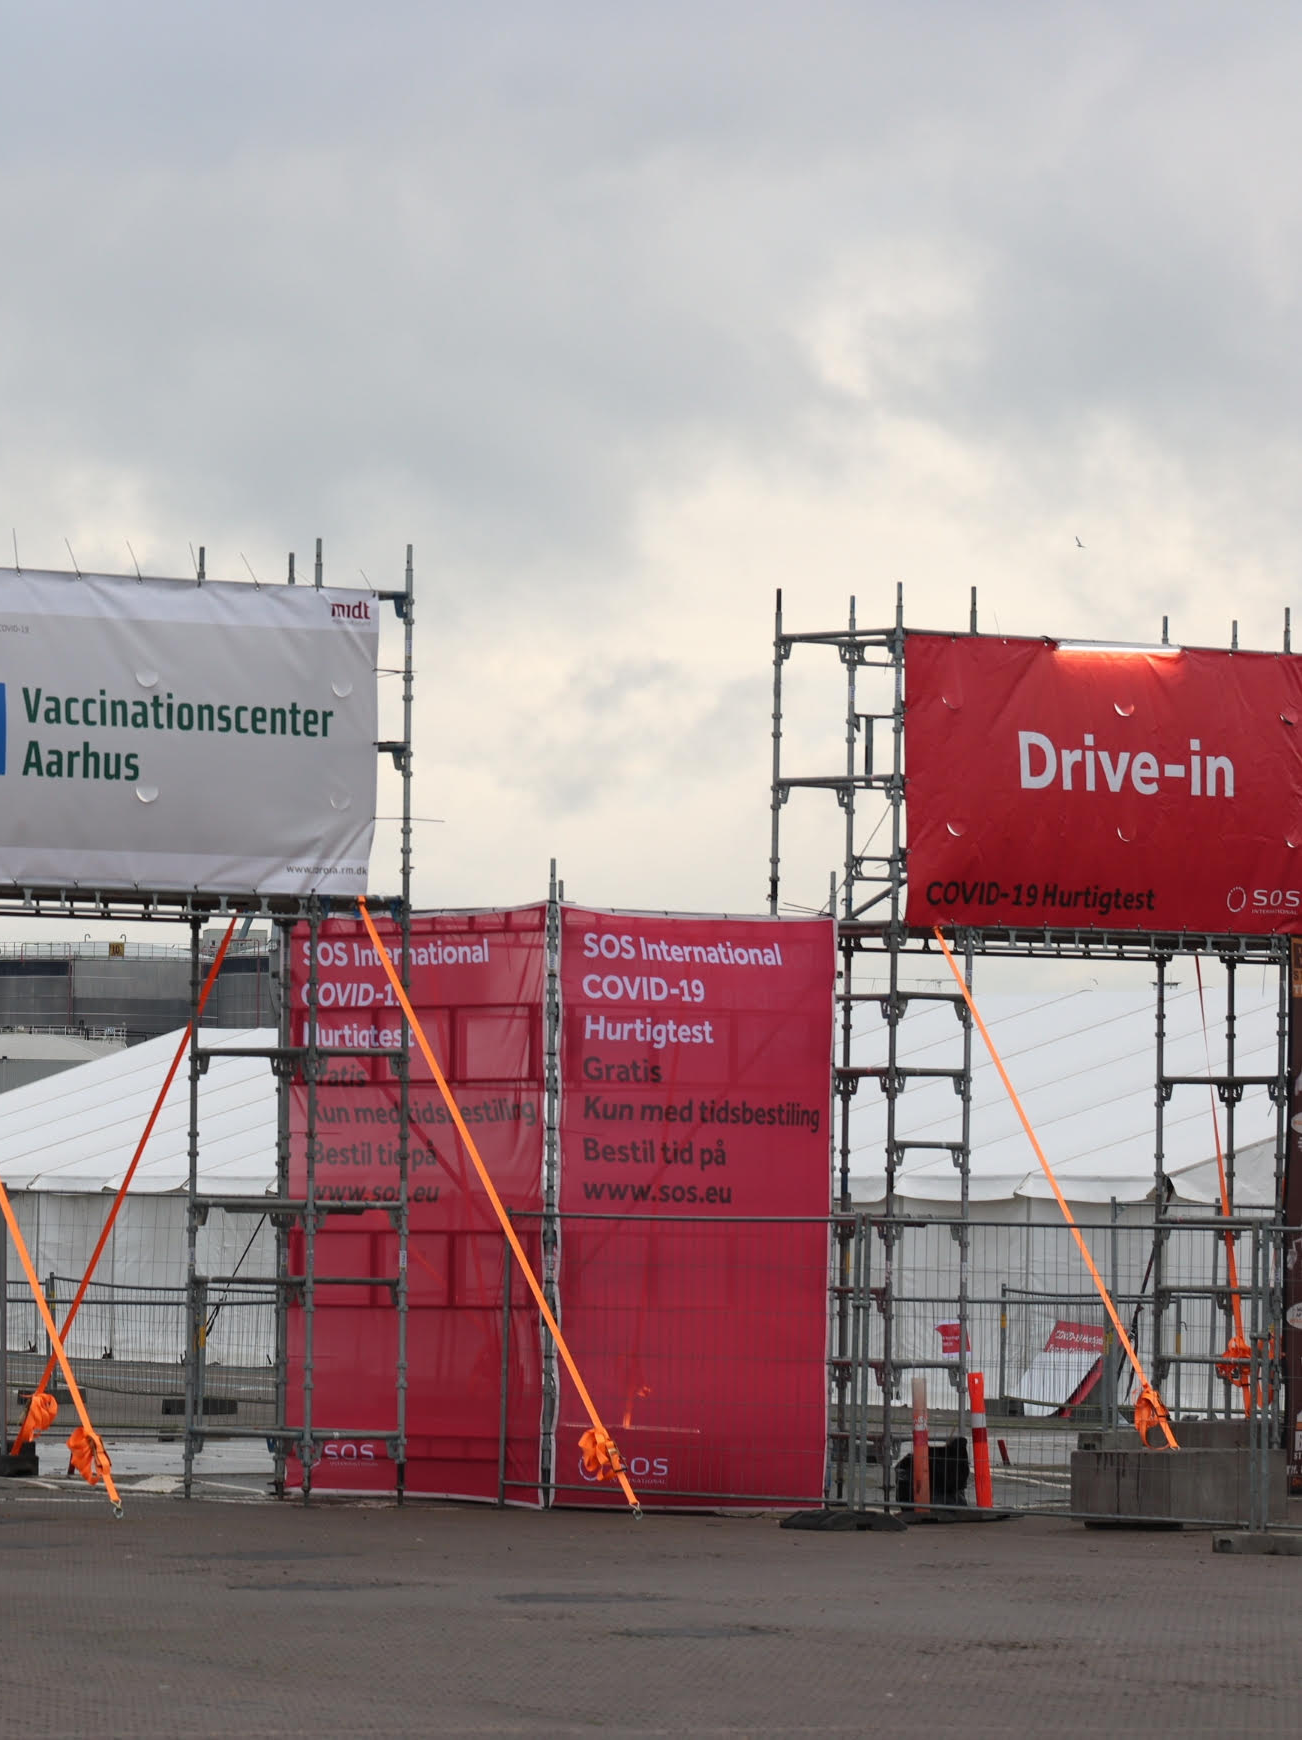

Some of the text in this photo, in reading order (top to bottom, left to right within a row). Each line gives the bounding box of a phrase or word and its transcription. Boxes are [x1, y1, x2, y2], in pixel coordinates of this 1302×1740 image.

[331, 601, 370, 620] midt
[22, 687, 334, 737] Vaccinationscenter
[22, 740, 140, 781] Aarhus
[1017, 730, 1234, 798] Drive-in
[926, 880, 1156, 915] COVID-19 Hurtigtest
[1252, 889, 1300, 907] SOS
[302, 940, 348, 967] SOS
[583, 932, 782, 967] SOS International
[300, 982, 401, 1007] COVID-1
[582, 974, 706, 1004] COVID-19
[583, 1015, 714, 1050] Hurtigtest
[314, 1064, 367, 1088] ratis
[583, 1053, 662, 1084] Gratis
[583, 1095, 820, 1133] Kun med tidsbestiling
[313, 1141, 373, 1167] Bestil
[411, 1140, 437, 1173] på
[583, 1137, 727, 1171] Bestil tid på
[313, 1184, 440, 1204] www.so.eu
[583, 1181, 732, 1204] www.sos.eu
[324, 1443, 374, 1461] SOS
[630, 1456, 669, 1476] OS
